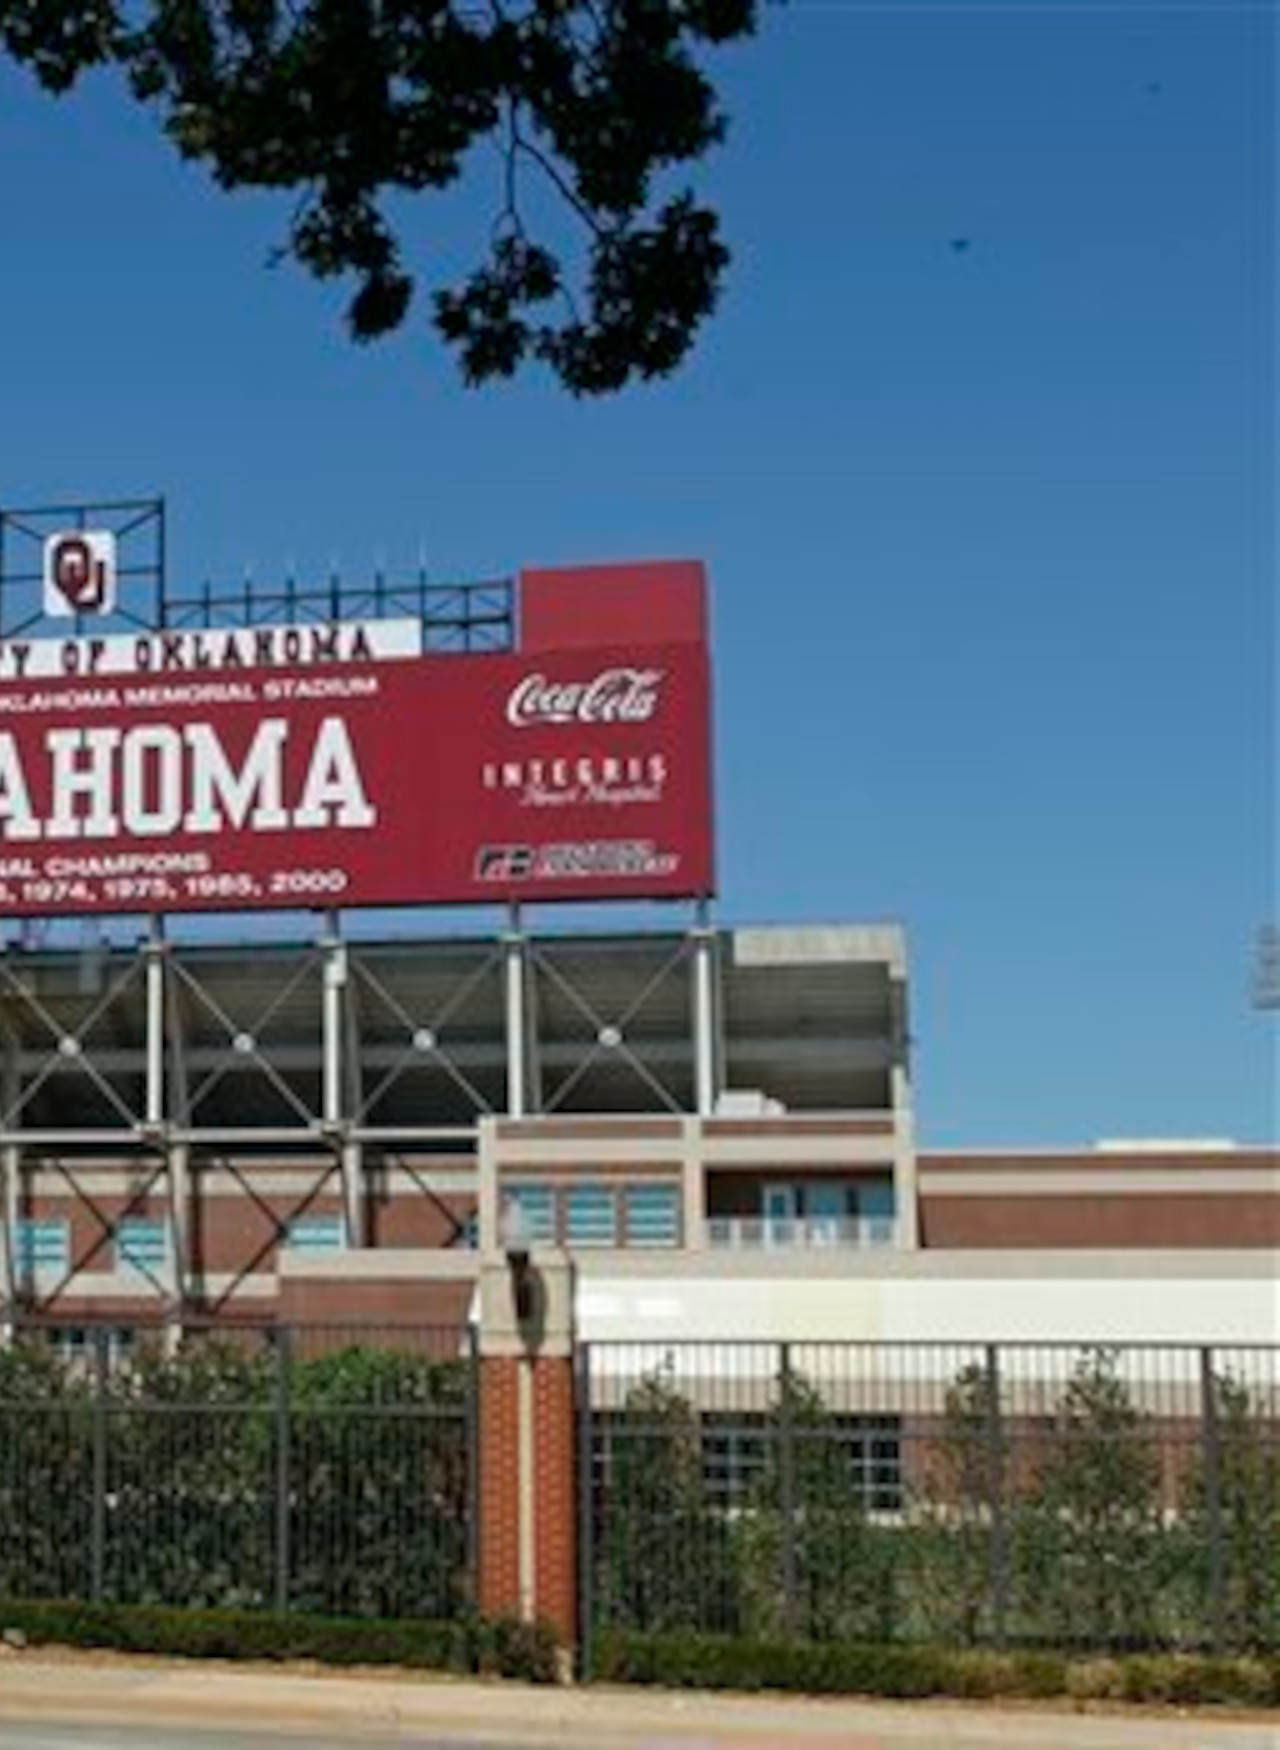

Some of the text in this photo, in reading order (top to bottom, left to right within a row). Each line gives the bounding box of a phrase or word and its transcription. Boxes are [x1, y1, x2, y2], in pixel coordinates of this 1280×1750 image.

[60, 640, 104, 674] OF
[134, 626, 374, 669] OKLAHOMA
[124, 684, 255, 707] MEMORIAL
[263, 677, 380, 700] STADIUM
[483, 754, 666, 787] INTEGRIS
[43, 851, 210, 878] CHAMPIONS
[22, 878, 97, 902] 1974,
[270, 868, 347, 893] 2000
